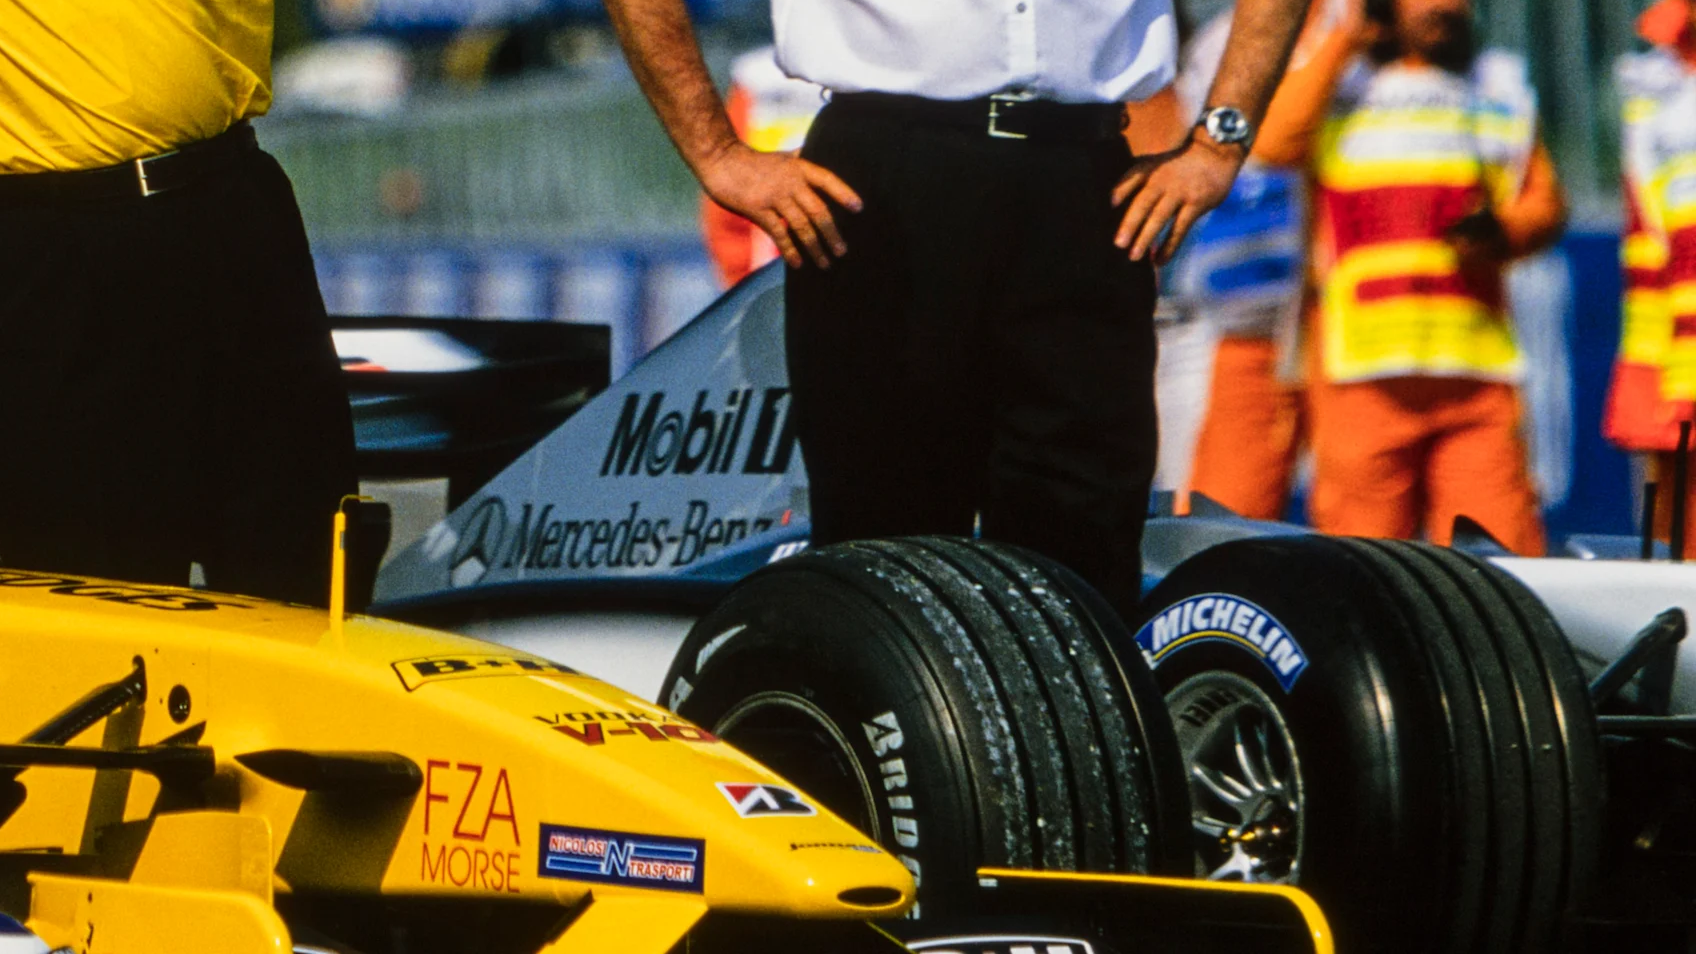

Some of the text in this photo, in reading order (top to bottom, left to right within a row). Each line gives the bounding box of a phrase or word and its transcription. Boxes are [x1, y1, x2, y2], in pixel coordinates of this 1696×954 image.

[599, 388, 754, 477] Mobil
[1152, 597, 1302, 676] MICHELIN
[550, 722, 721, 746] V-10
[424, 759, 521, 847] FZA
[421, 842, 521, 893] MORSE
[549, 835, 607, 858] NICOLOSI
[629, 859, 695, 883] TRASPORTI
